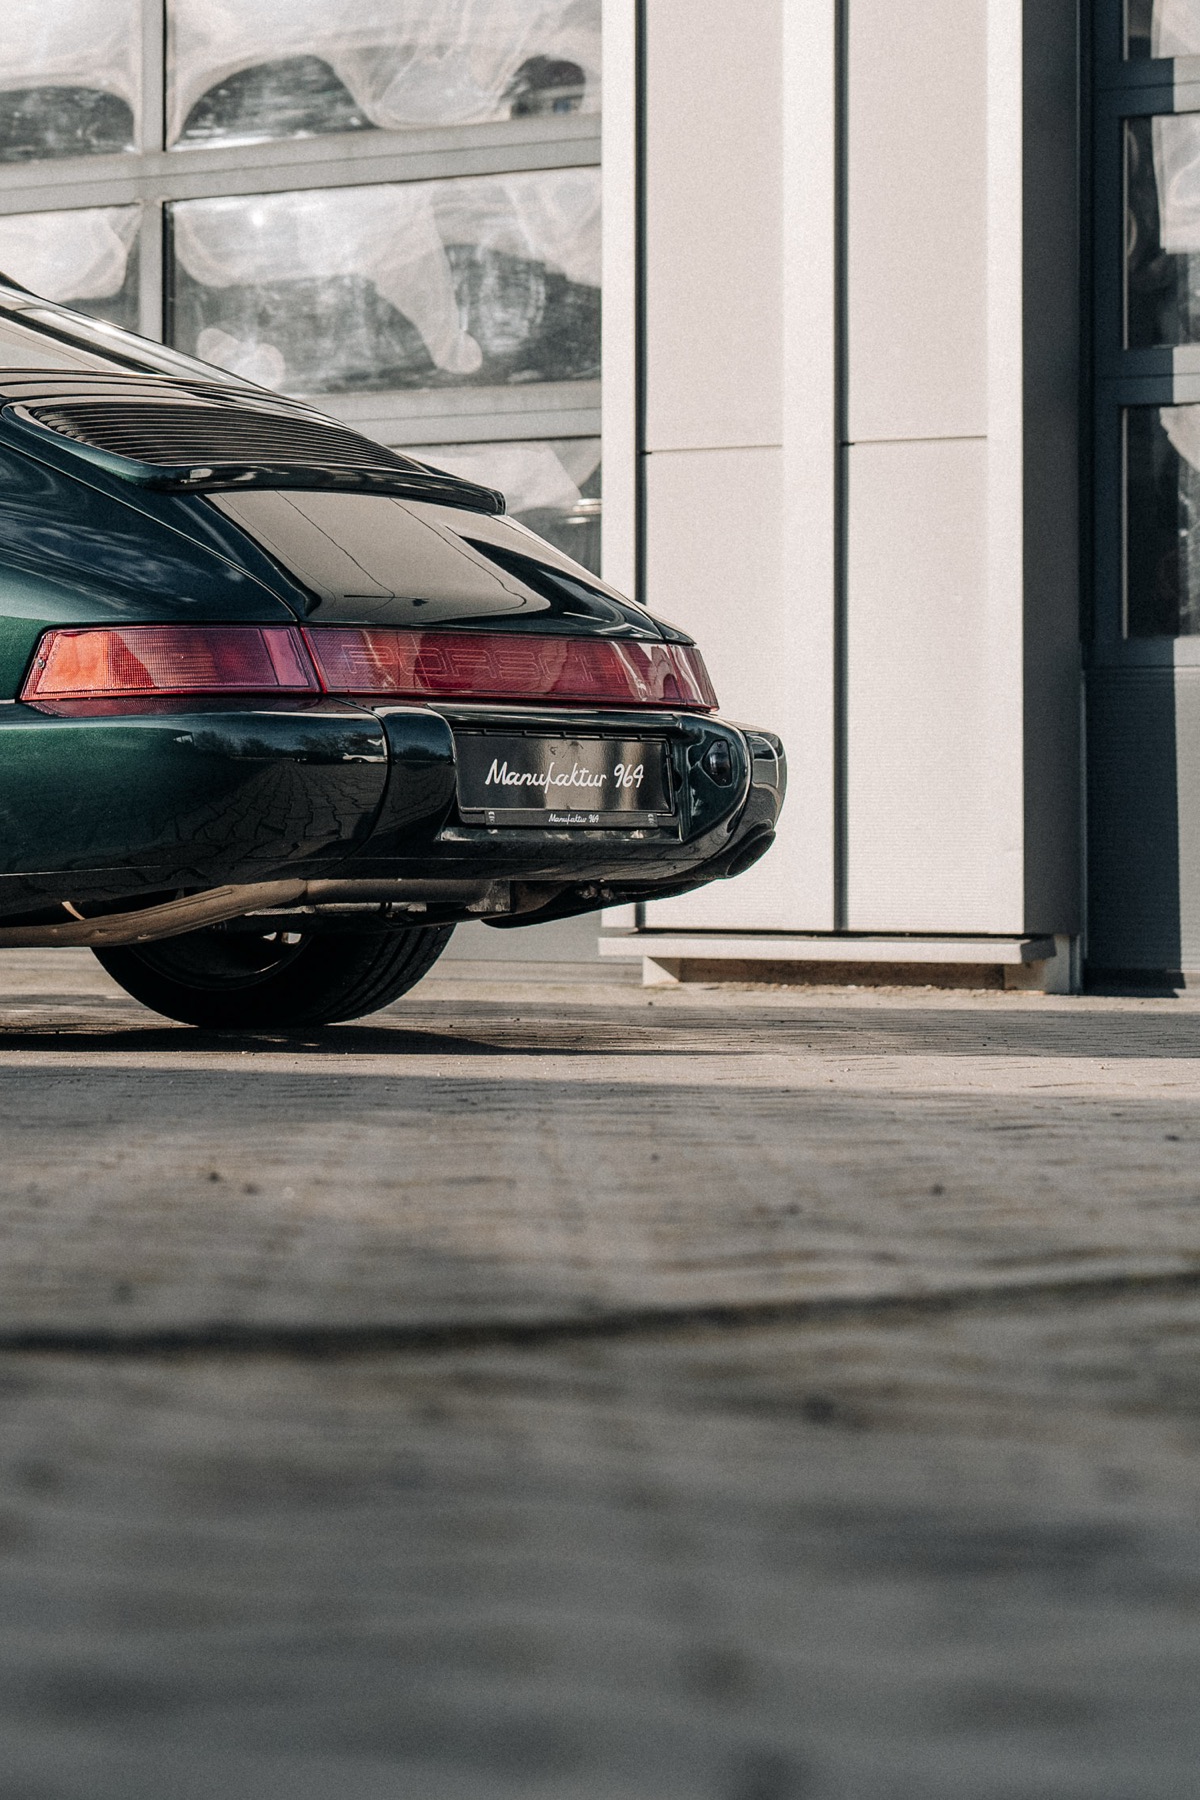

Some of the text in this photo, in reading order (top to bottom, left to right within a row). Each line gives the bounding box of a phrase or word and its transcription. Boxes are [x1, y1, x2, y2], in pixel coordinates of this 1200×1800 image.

[340, 644, 650, 685] PORSCH
[485, 758, 644, 794] Manufaktur 964
[548, 813, 599, 824] Manufaktur 964
